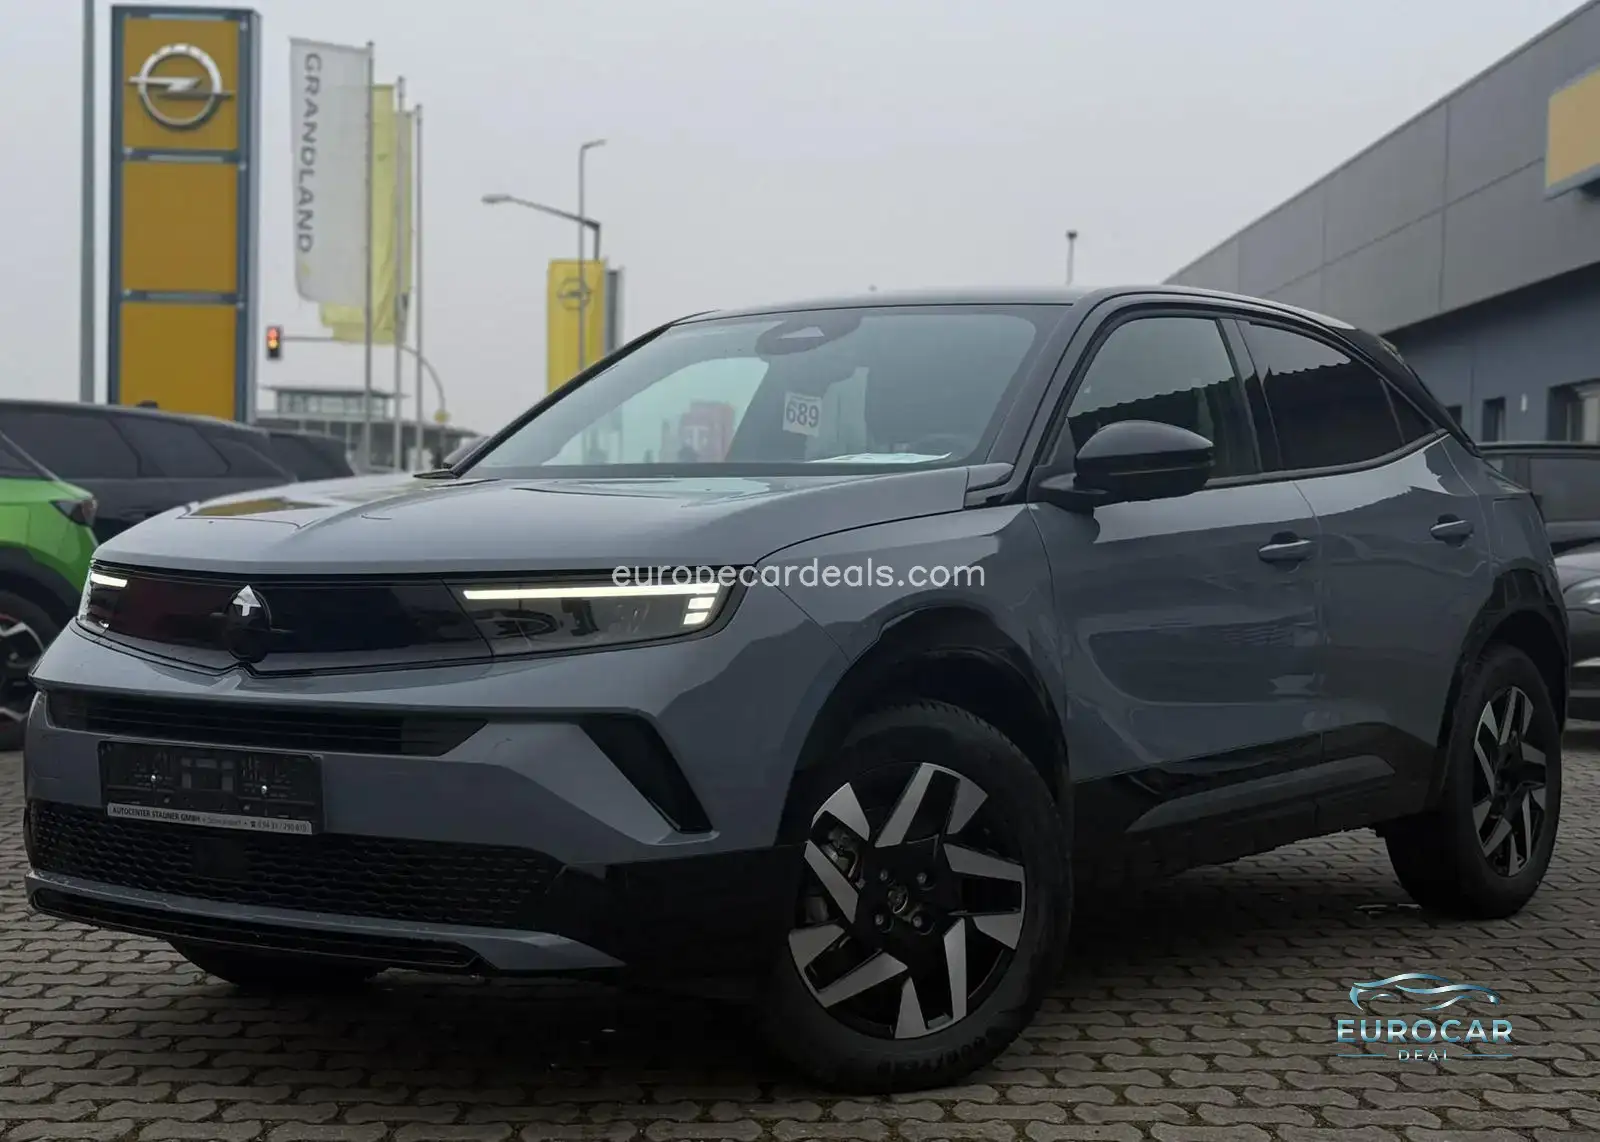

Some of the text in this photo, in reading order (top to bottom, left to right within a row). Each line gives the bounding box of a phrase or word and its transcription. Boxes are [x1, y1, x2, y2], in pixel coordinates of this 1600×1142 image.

[297, 53, 321, 254] GRANDLAND
[785, 401, 819, 428] 689
[113, 806, 150, 817] AUTOCENTER
